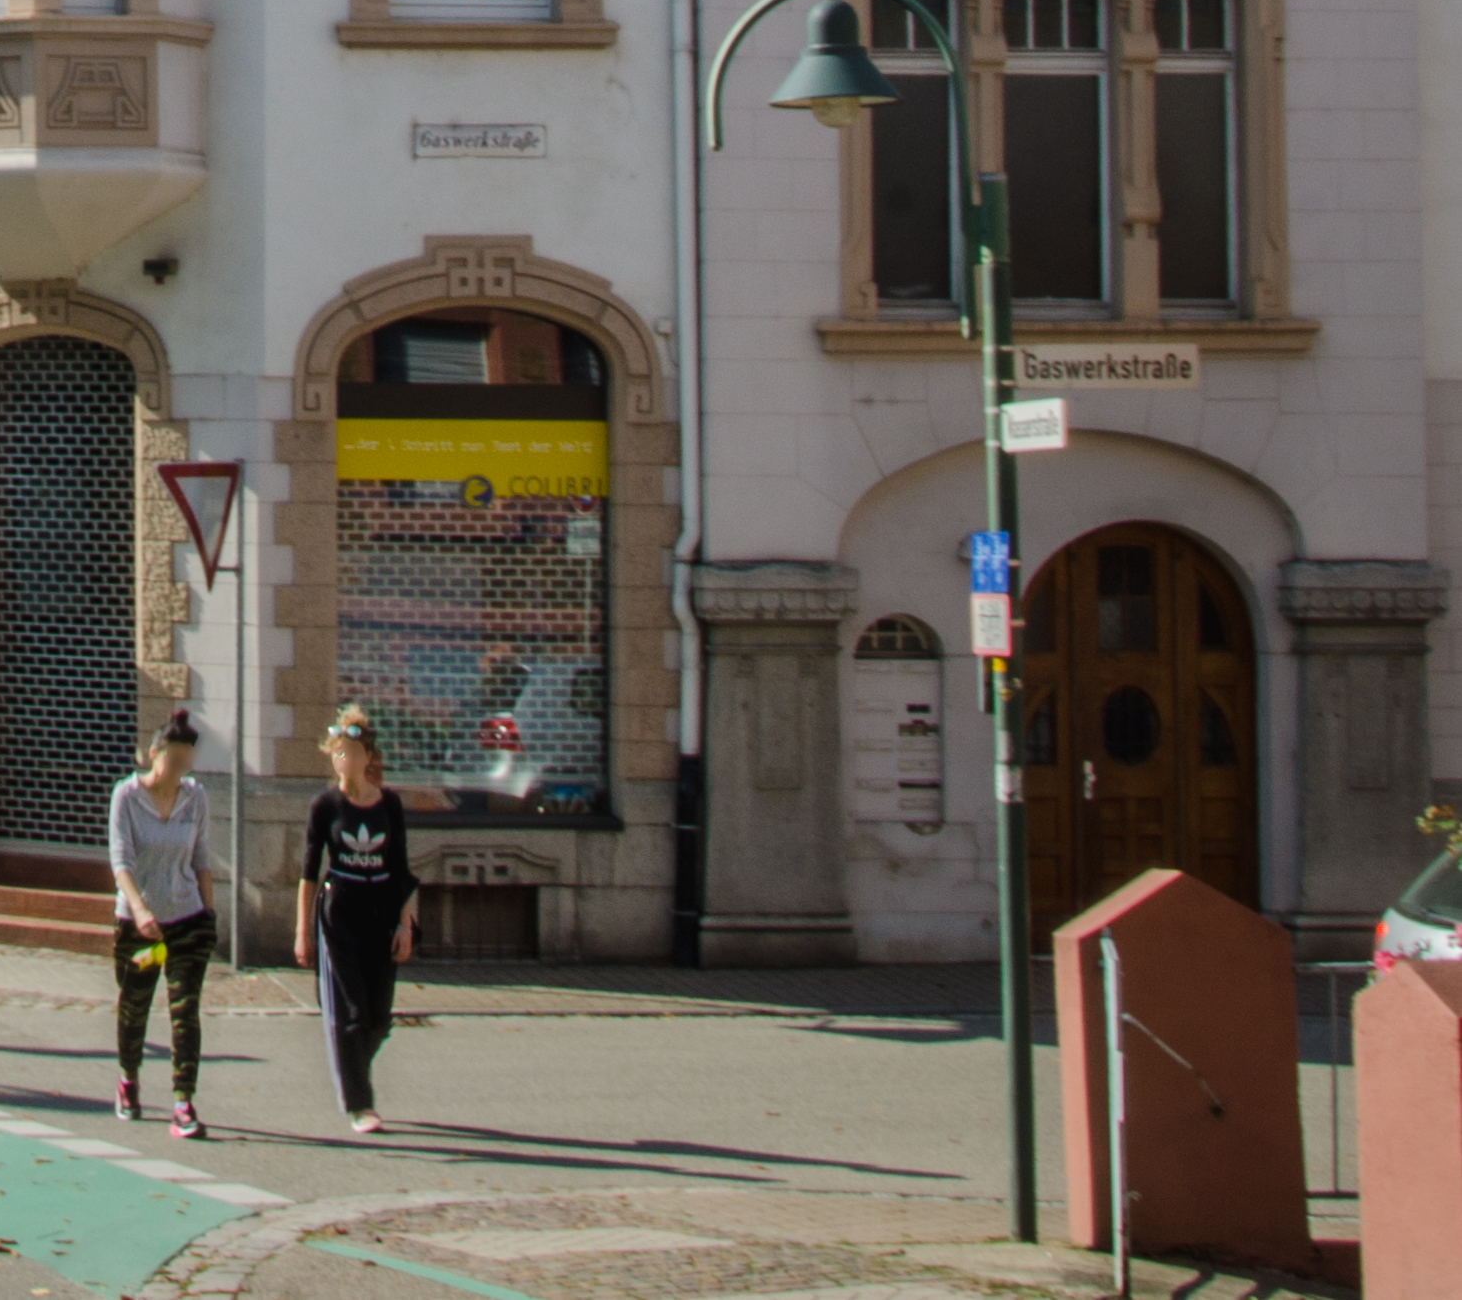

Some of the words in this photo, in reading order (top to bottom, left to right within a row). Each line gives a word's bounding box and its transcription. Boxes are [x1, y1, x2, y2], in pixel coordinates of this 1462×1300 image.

[419, 130, 541, 152] Gaswerkstraße
[1024, 352, 1193, 379] Gaswerkstraße
[509, 476, 604, 498] COLIBRI
[338, 851, 384, 868] adidas
